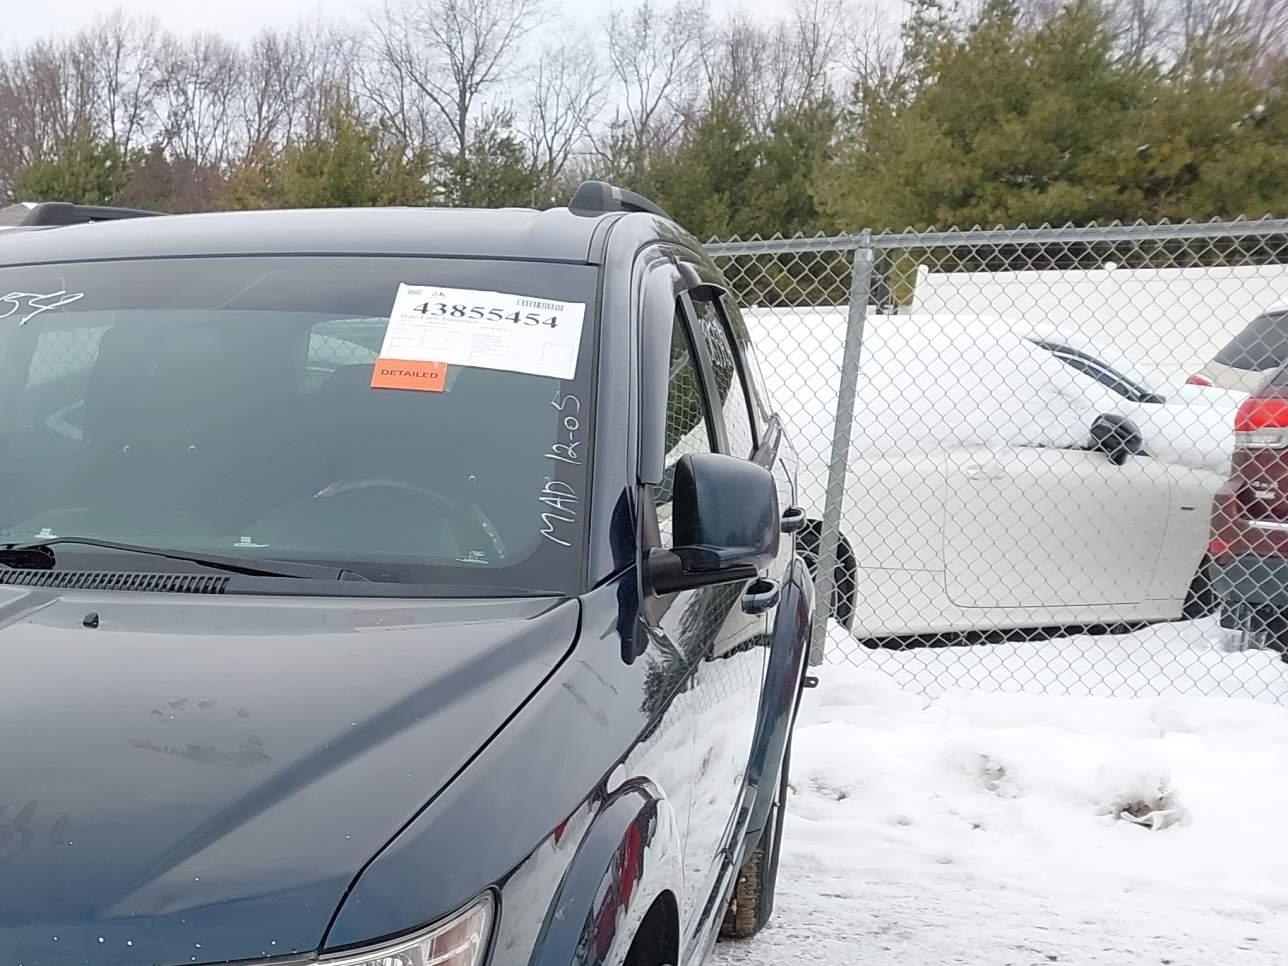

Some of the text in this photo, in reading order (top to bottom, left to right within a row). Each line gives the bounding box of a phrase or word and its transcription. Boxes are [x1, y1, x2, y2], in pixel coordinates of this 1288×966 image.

[413, 301, 560, 329] 43855454
[380, 368, 439, 380] DETAILED
[538, 389, 582, 547] MAD 12-05
